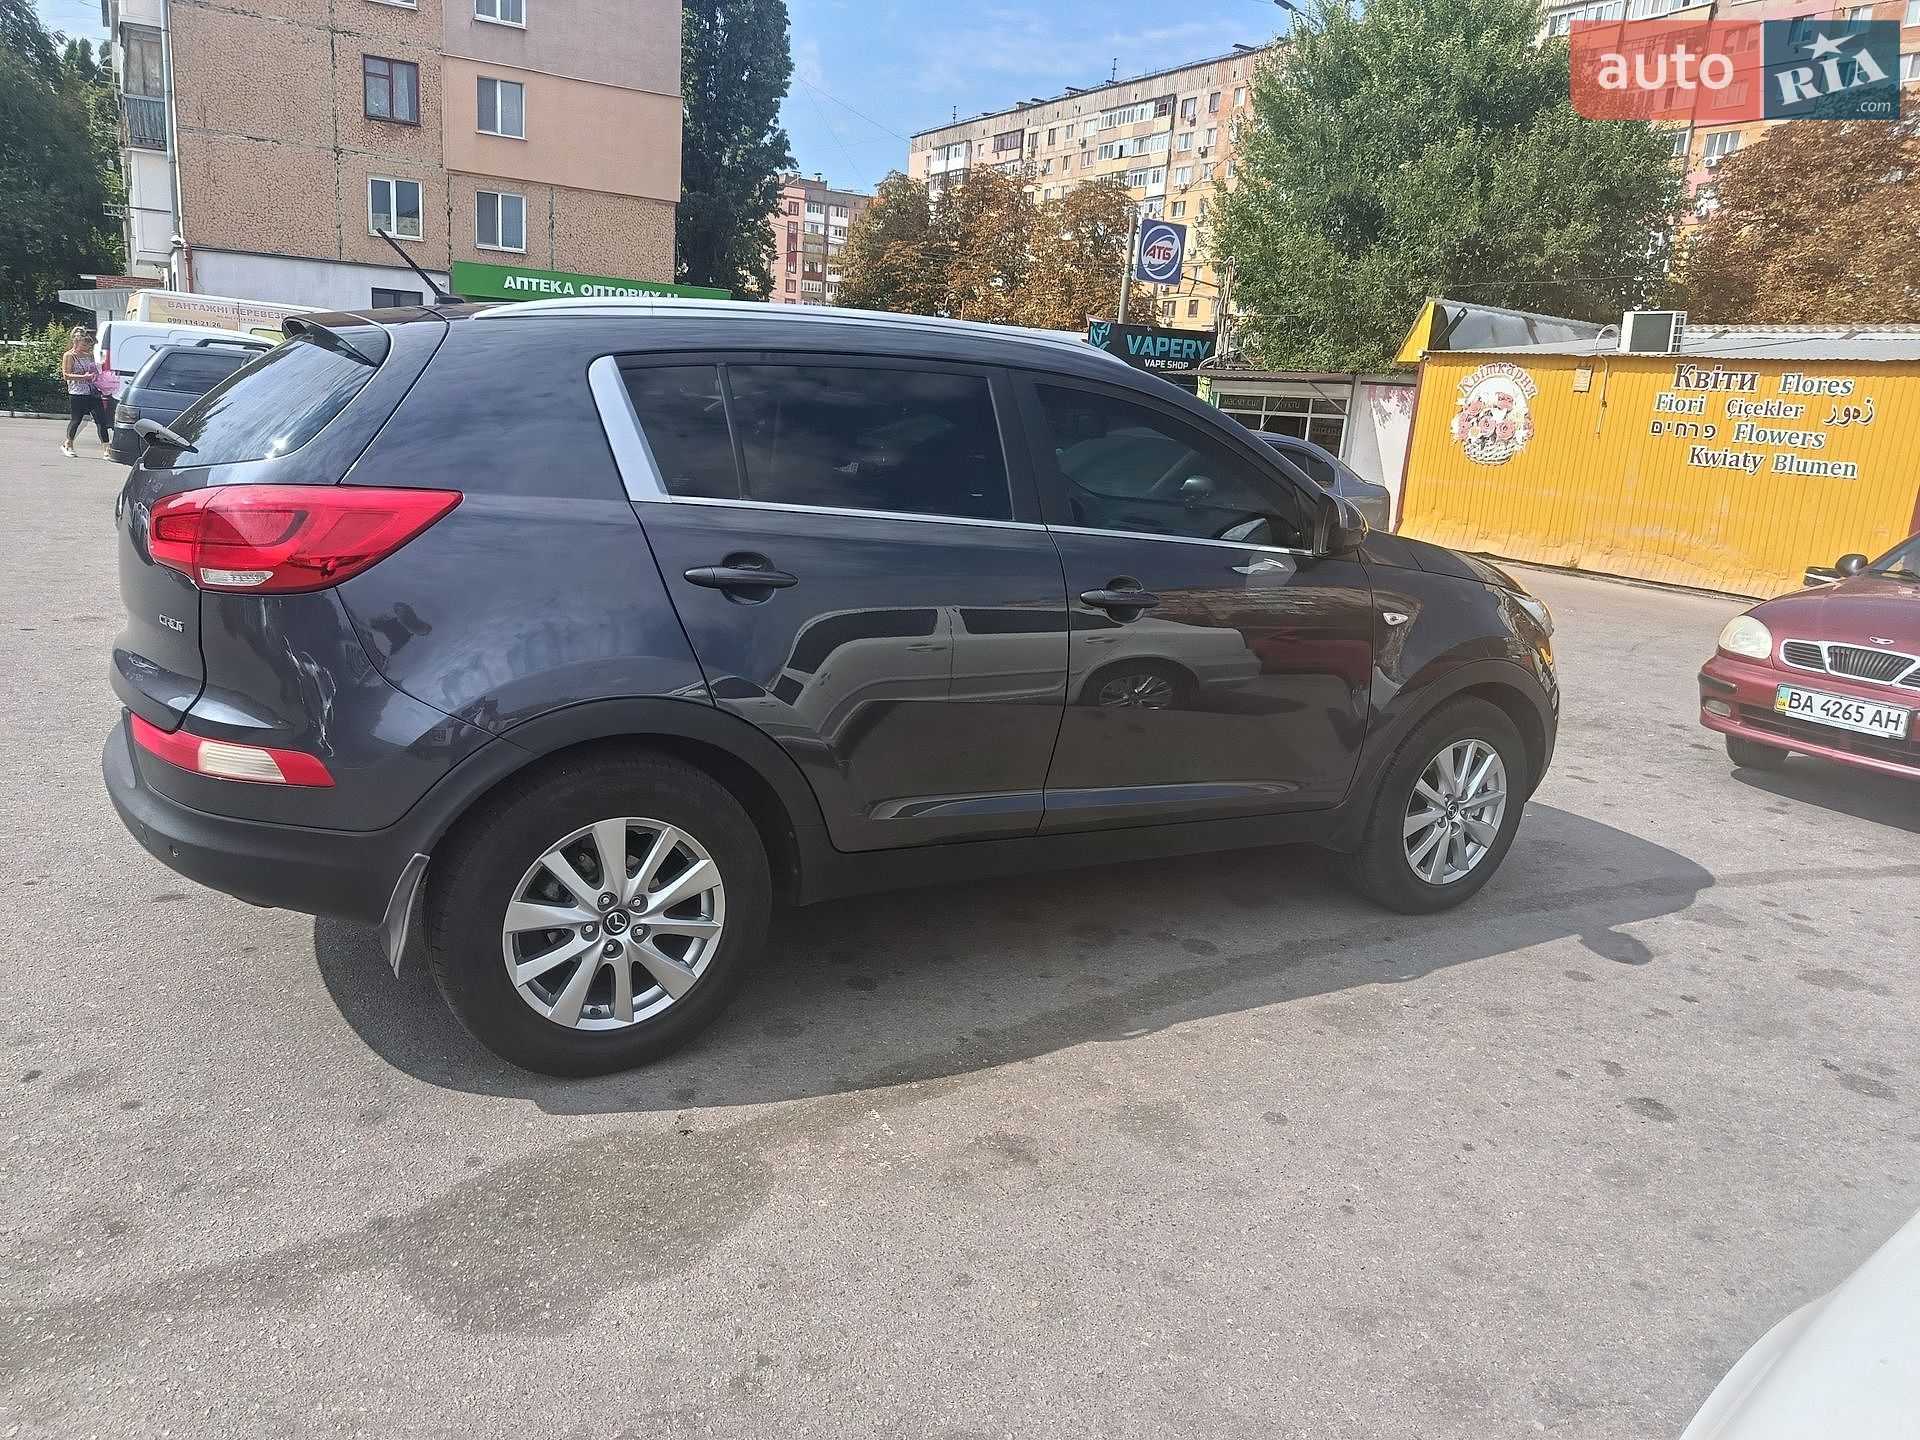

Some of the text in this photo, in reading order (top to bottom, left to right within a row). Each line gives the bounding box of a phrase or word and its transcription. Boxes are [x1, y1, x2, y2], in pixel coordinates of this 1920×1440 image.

[503, 275, 575, 295] АПТЕКА
[167, 301, 228, 314] ВАНТАЖНІ
[1126, 334, 1211, 360] VAPERY
[1144, 359, 1189, 370] VAPE SHOP
[1673, 363, 1759, 392] Квіти
[1780, 373, 1855, 395] Flores
[1655, 393, 1705, 413] Fiori
[1726, 398, 1804, 419] Çiçekler
[1823, 398, 1875, 425] زهور
[1650, 421, 1717, 439] פרחים
[1733, 423, 1827, 448] Flowers
[1688, 446, 1858, 477] Kwiaty Blumen
[1788, 692, 1901, 731] BA 4265 AH
